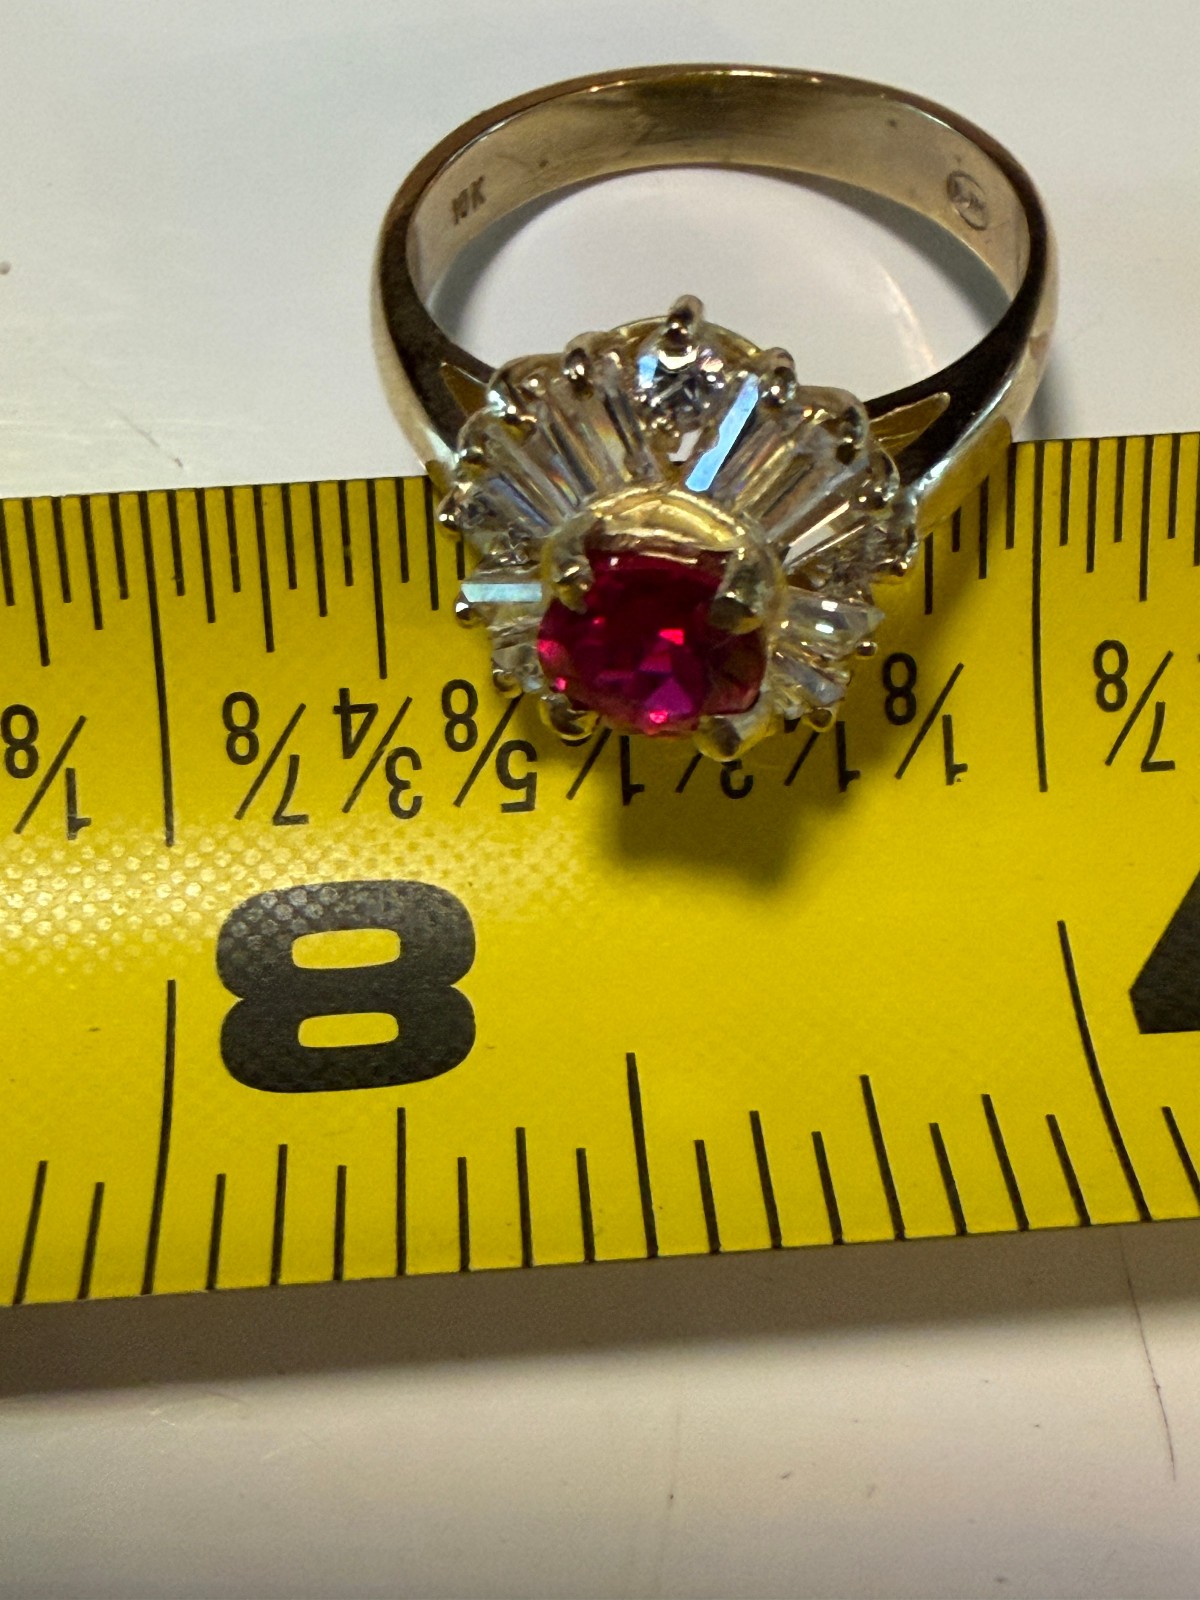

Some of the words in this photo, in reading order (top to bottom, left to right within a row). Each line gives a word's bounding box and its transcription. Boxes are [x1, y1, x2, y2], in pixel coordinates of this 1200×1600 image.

[0, 704, 92, 840] 1/8
[222, 691, 310, 826] 7/8
[333, 687, 424, 820] 3/4
[441, 678, 538, 814] 5/8
[882, 652, 969, 786] 1/8
[1093, 639, 1176, 773] 7/8
[216, 879, 476, 1093] 8
